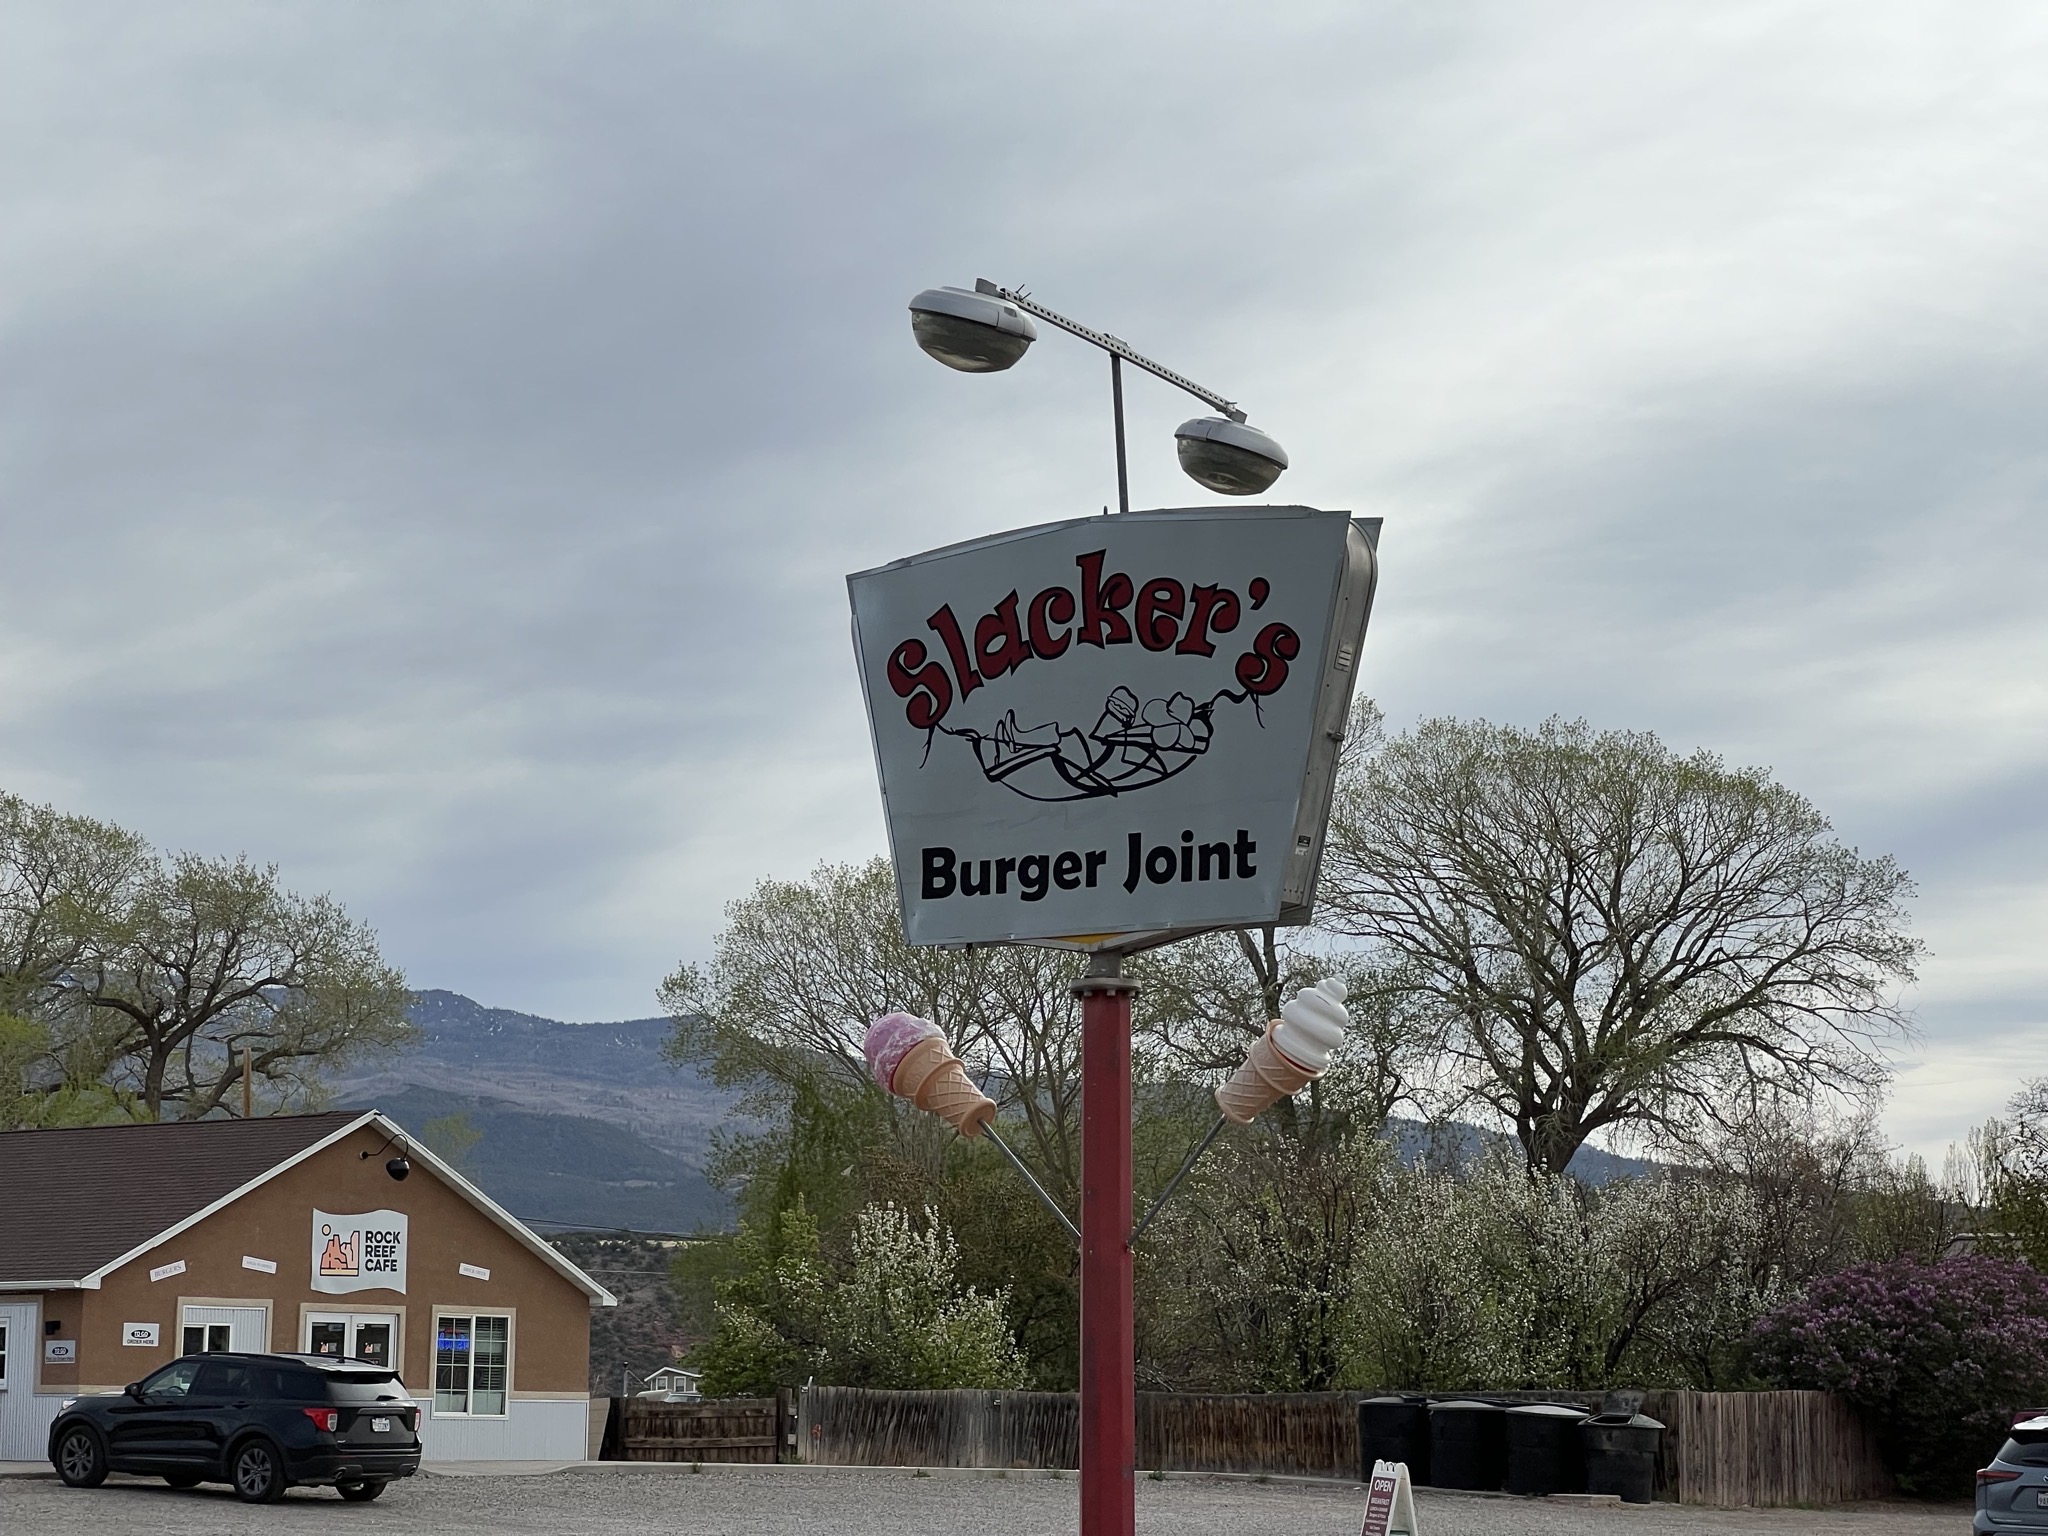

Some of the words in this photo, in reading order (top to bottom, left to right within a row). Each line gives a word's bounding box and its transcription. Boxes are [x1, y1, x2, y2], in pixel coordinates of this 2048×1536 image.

[887, 549, 1301, 729] Slacker's
[921, 847, 1107, 901] Burger
[1123, 829, 1257, 894] Joint
[365, 1231, 401, 1244] ROCK
[365, 1245, 397, 1258] REEF
[154, 1264, 182, 1278] BURGERS
[365, 1259, 398, 1272] CAFE
[1374, 1479, 1394, 1492] OPEN
